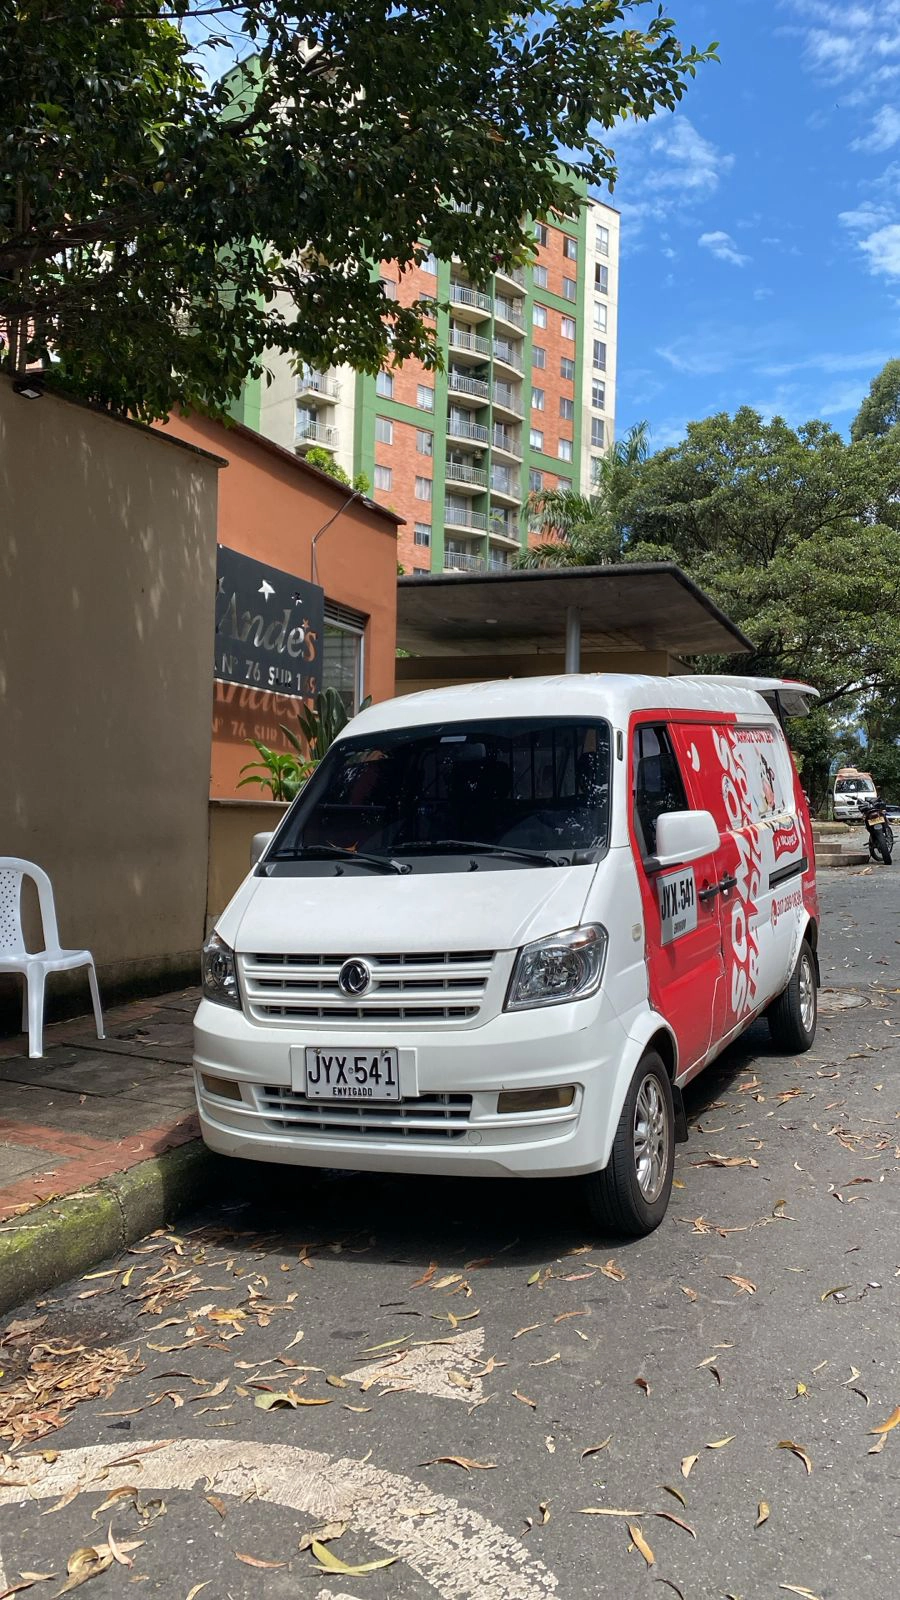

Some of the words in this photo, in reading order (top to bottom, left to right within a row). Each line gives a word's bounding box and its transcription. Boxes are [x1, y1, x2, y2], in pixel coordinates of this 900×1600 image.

[245, 661, 261, 682] 76
[267, 666, 292, 687] SUR
[332, 1086, 373, 1097] ENVIGADO
